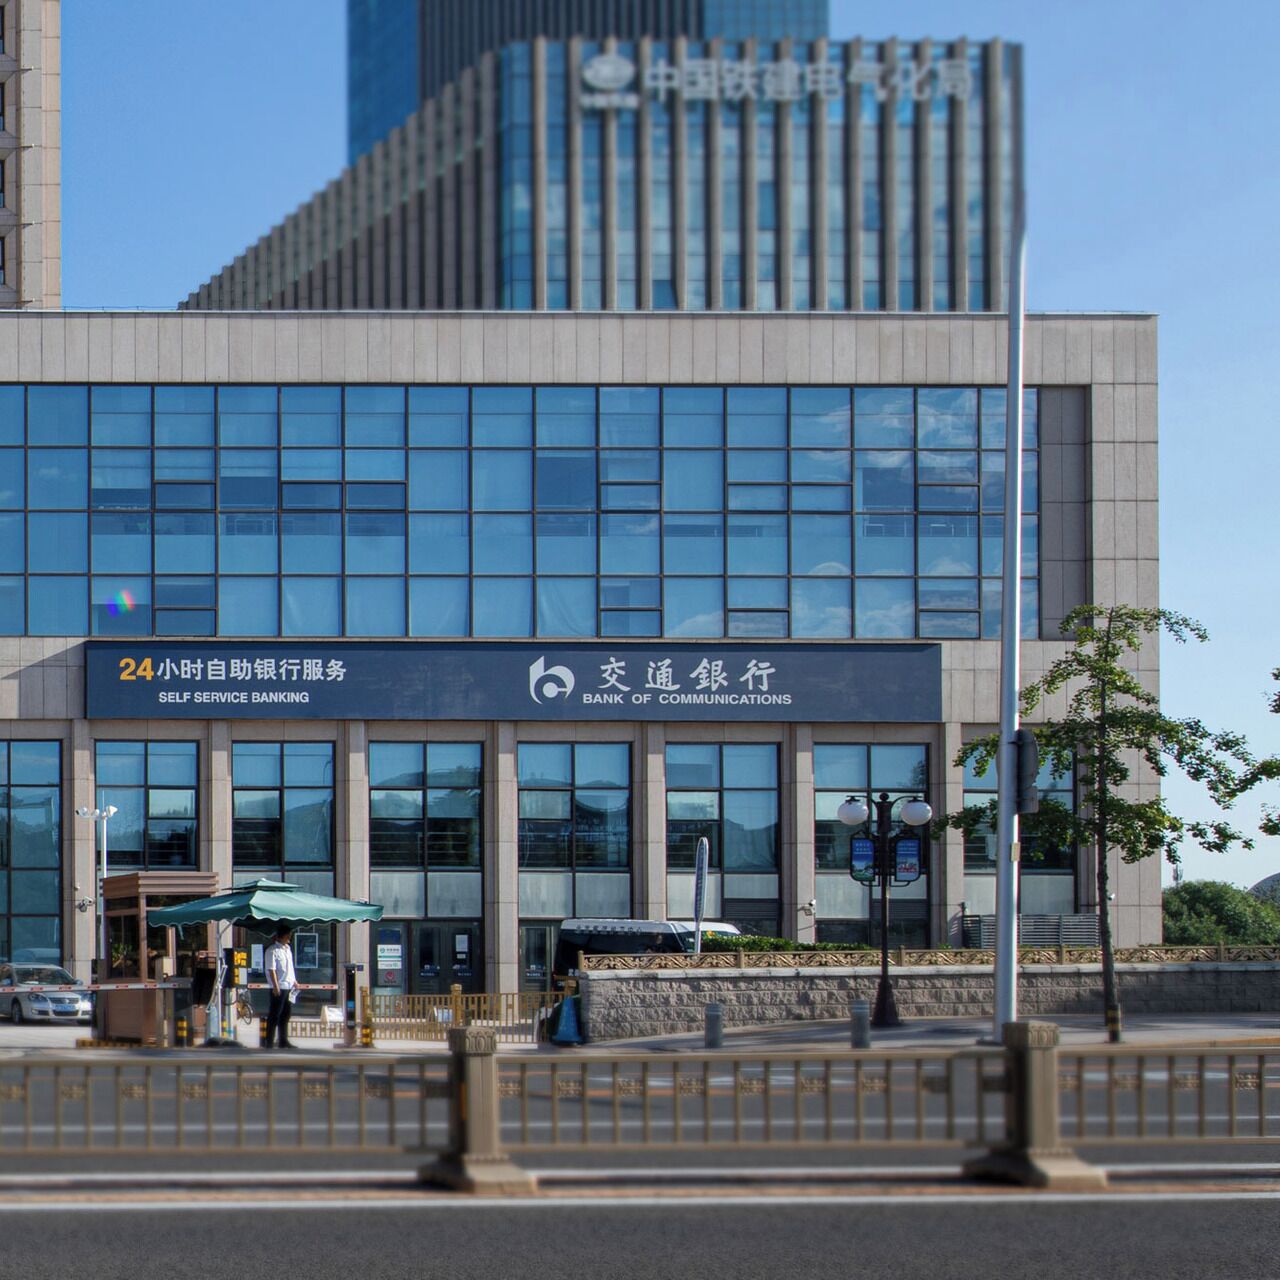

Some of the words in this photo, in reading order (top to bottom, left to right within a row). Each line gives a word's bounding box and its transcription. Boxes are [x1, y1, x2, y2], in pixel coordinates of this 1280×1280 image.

[644, 58, 974, 102] 中国铁建电气化局
[118, 657, 347, 682] 24小时自助银行服务
[597, 655, 777, 692] 交通銀行
[158, 691, 191, 703] SELF
[194, 691, 248, 703] SERVICE
[251, 691, 309, 703] BANKING
[582, 693, 624, 705] BANK
[631, 693, 652, 705] OF
[658, 693, 792, 705] COMMUNICATIONS
